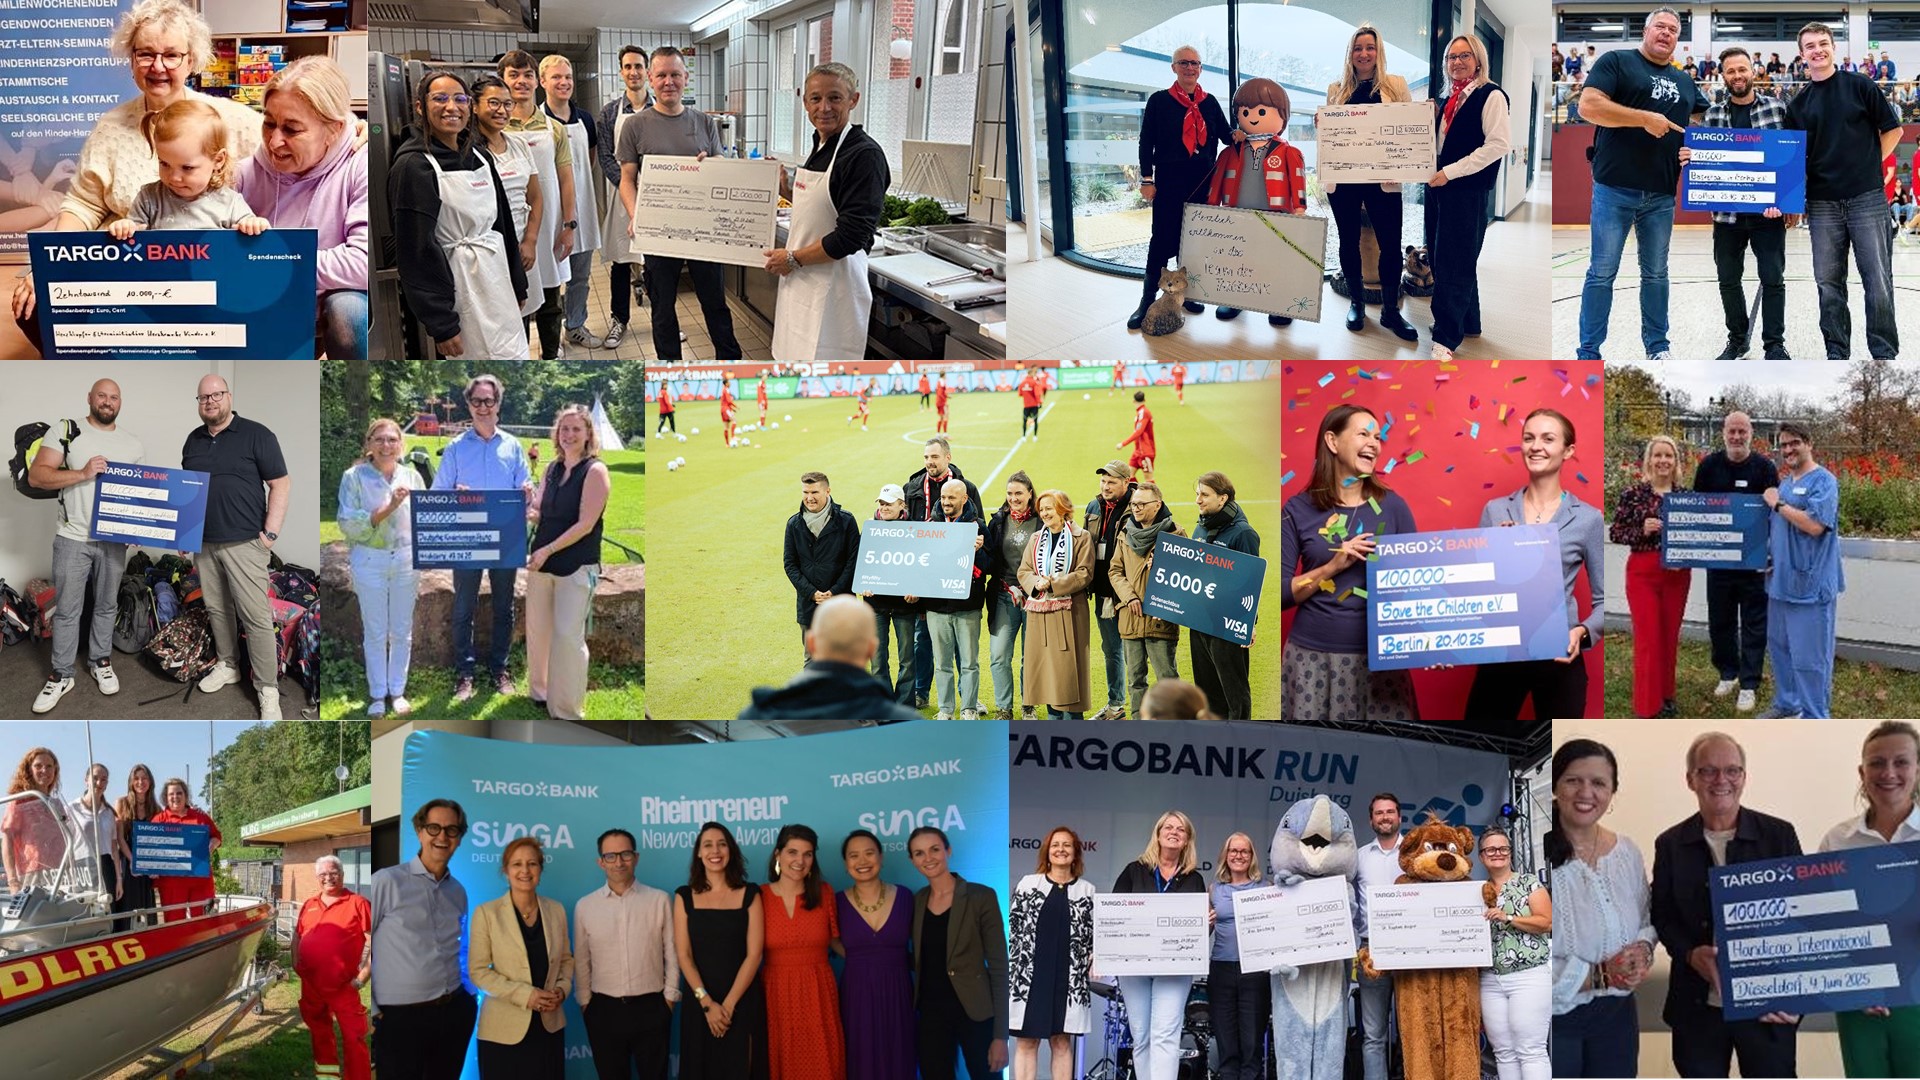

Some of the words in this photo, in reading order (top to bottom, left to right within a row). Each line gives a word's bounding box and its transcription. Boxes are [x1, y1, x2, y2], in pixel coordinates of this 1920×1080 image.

[62, 96, 70, 104] &
[72, 95, 120, 104] KONTAKT
[1, 113, 85, 123] SEELSORGLICHE
[27, 130, 43, 138] den
[248, 253, 302, 262] Spendenscheck
[54, 287, 111, 300] Zehntausend
[865, 550, 915, 566] 5.000
[918, 553, 931, 567] €
[1055, 552, 1066, 573] WIR
[940, 579, 966, 590] VISA
[1155, 568, 1202, 595] 5.000
[1204, 583, 1218, 600] €
[1382, 602, 1413, 619] Save
[1416, 602, 1433, 617] the
[1437, 599, 1483, 615] Children
[1223, 617, 1248, 635] VISA
[1436, 632, 1485, 648] 20.10.25
[1273, 750, 1360, 785] RUN
[641, 795, 789, 827] Rheinpreneur
[241, 824, 260, 837] DLRG
[1733, 939, 1792, 958] Handicap
[1798, 931, 1873, 953] International
[0, 938, 146, 1000] DLRG
